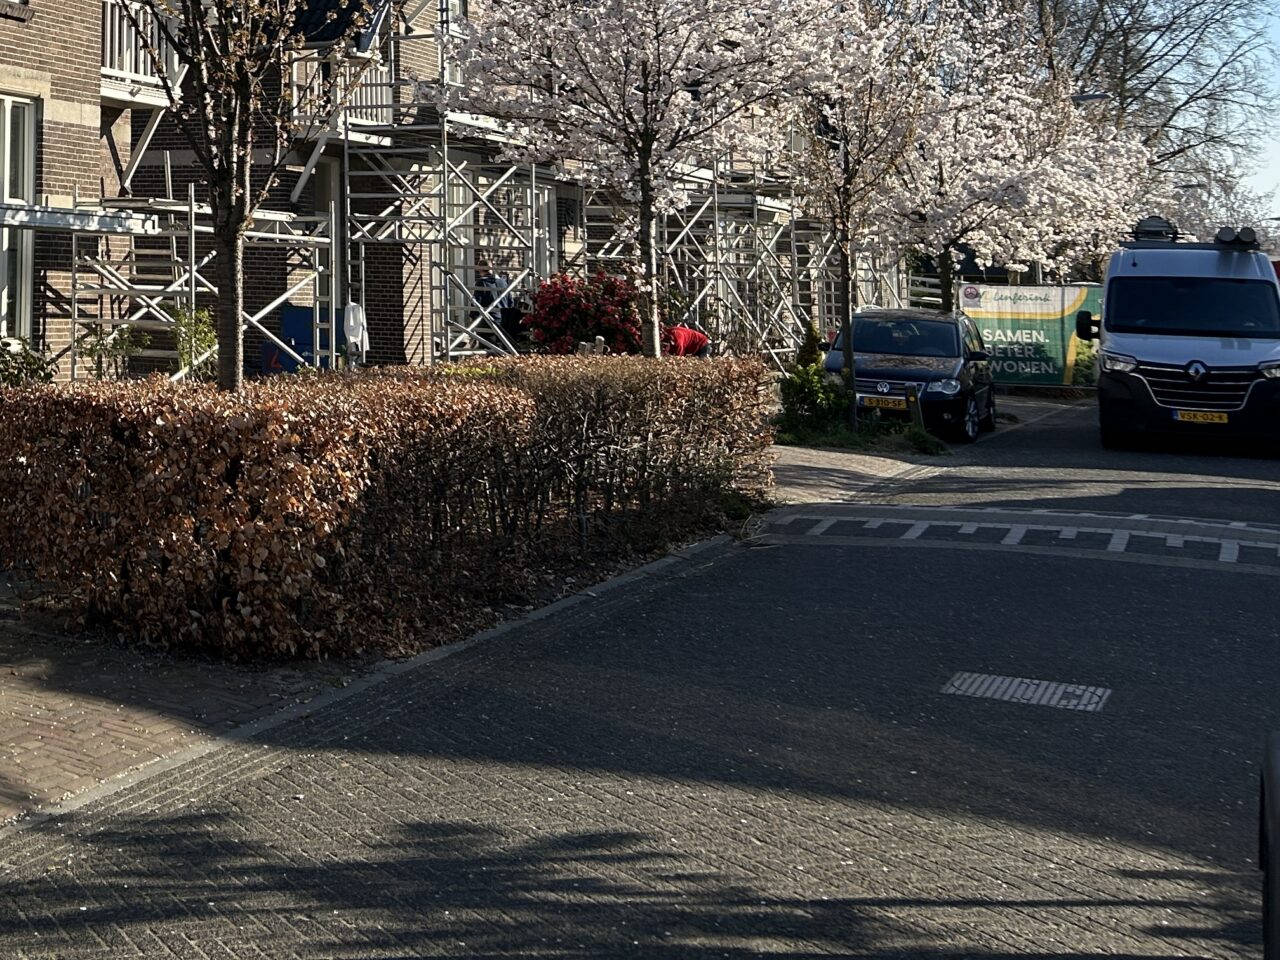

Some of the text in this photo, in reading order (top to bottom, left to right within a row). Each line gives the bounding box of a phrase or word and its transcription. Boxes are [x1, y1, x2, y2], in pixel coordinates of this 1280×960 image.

[983, 328, 1050, 343] SAMEN.
[984, 344, 1040, 358] BETER.
[988, 360, 1059, 374] WONEN.
